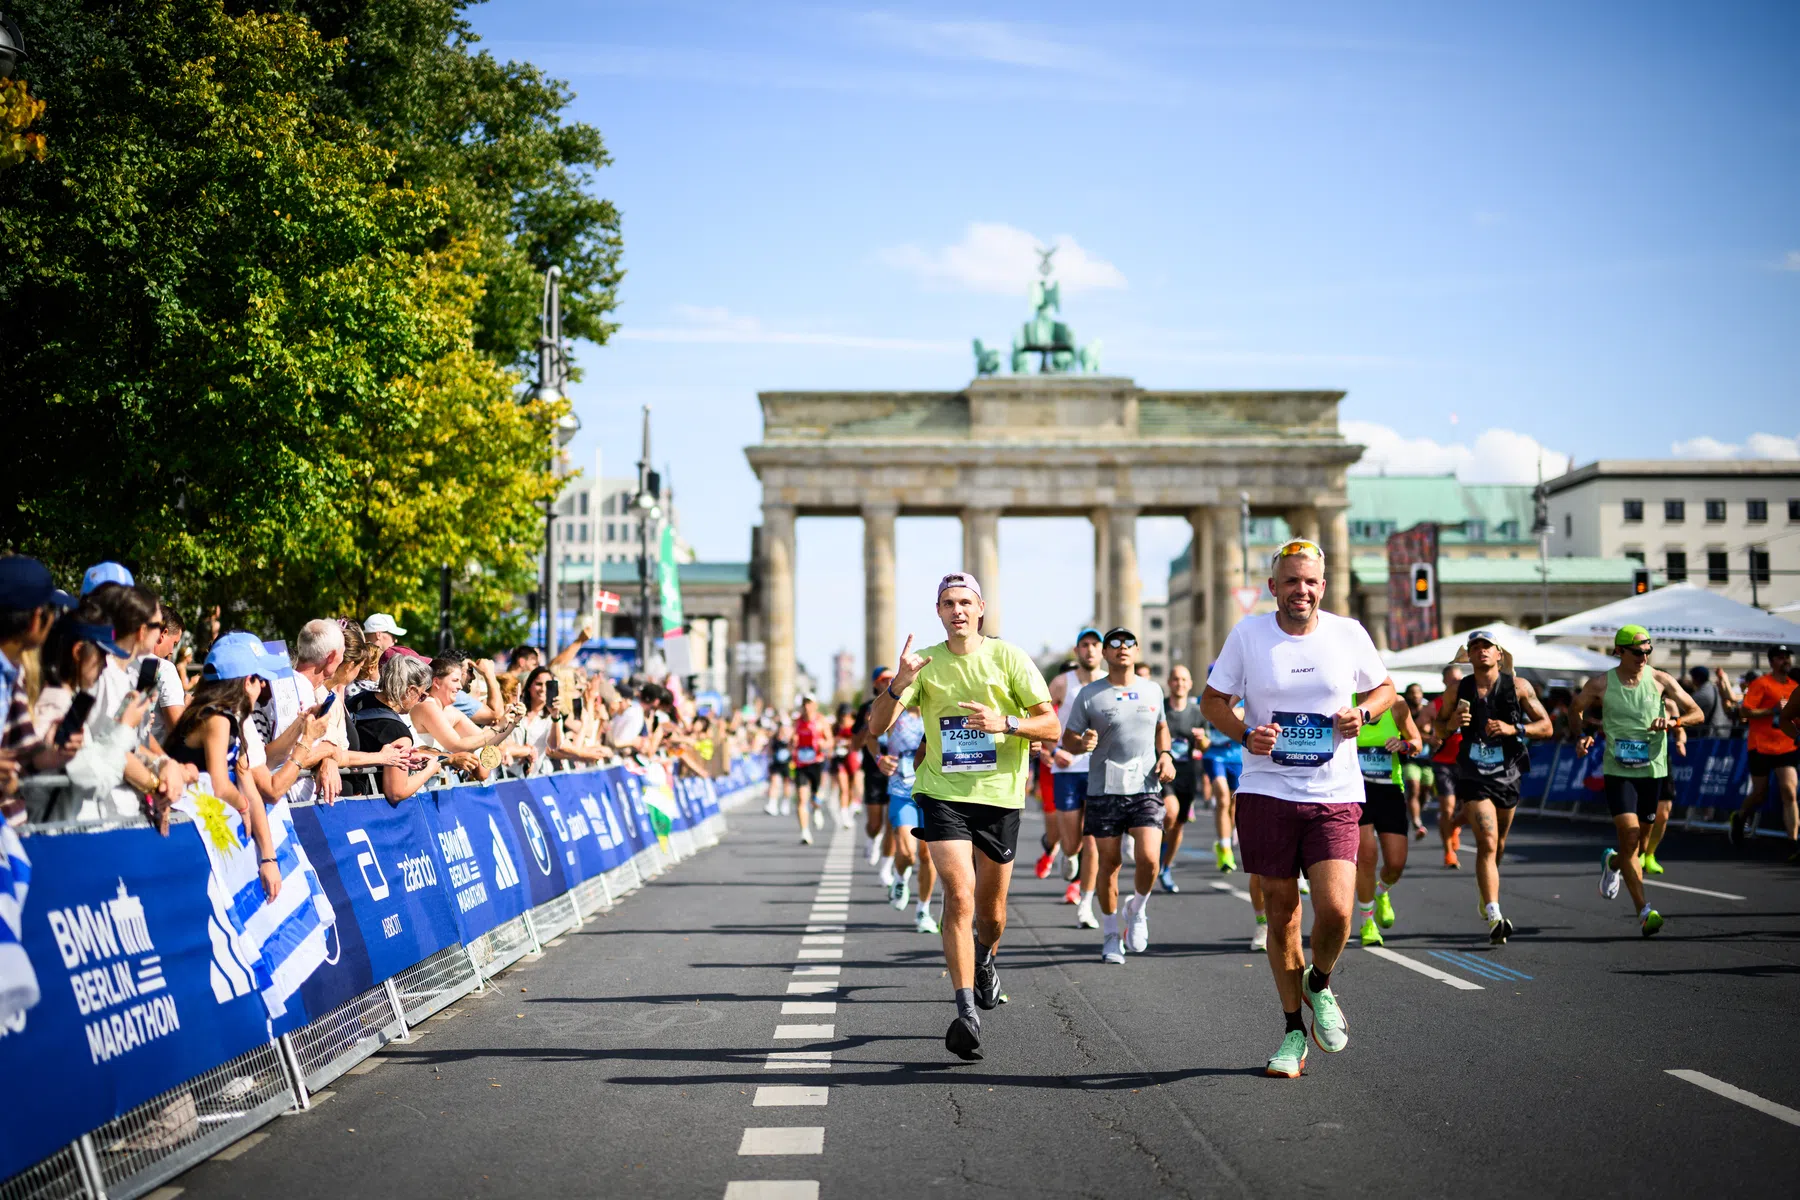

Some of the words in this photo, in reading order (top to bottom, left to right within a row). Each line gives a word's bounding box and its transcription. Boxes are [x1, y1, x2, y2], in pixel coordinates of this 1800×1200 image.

[949, 730, 986, 740] 24306
[1282, 728, 1323, 739] 65993
[1288, 739, 1317, 747] Siegfried
[954, 752, 984, 760] zalando
[1286, 753, 1319, 761] zalando
[437, 829, 464, 865] BMW
[396, 849, 438, 893] zalando
[448, 861, 472, 889] BERLIN
[456, 881, 489, 914] MARATHON
[47, 900, 121, 970] BMW
[381, 913, 403, 939] ABBOTT
[70, 959, 138, 1016] BERLIN
[85, 993, 181, 1065] MARATHON
